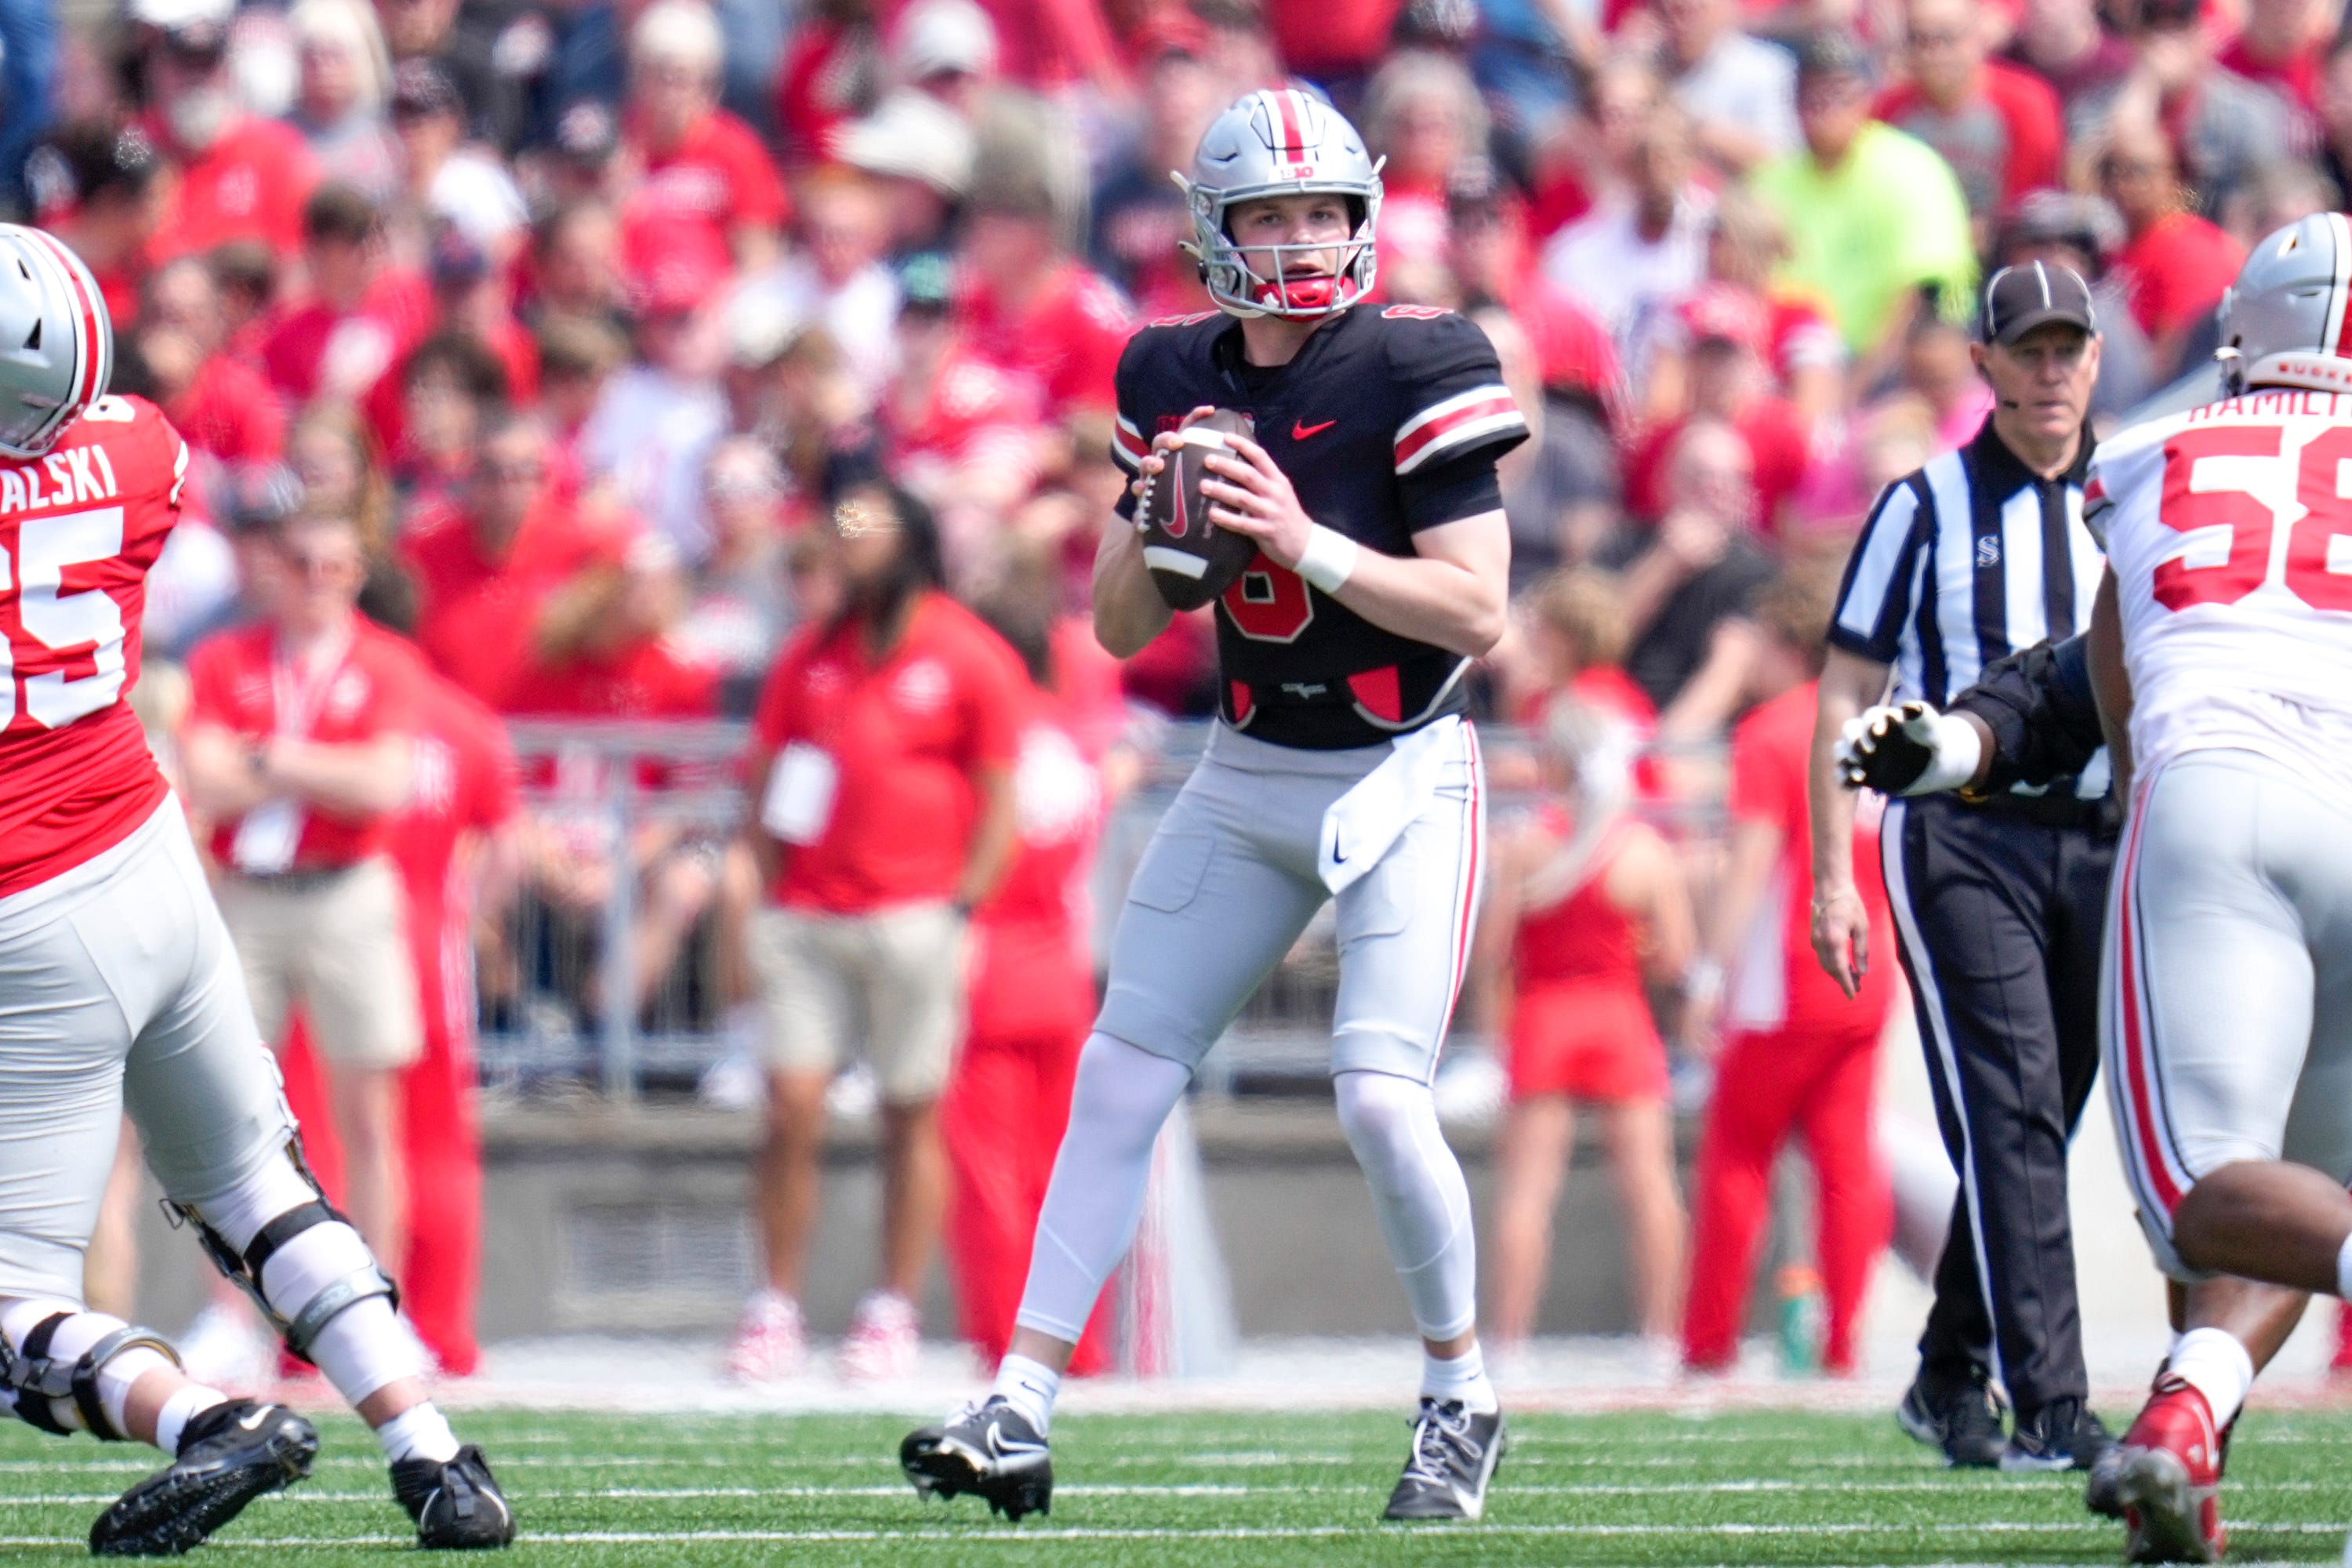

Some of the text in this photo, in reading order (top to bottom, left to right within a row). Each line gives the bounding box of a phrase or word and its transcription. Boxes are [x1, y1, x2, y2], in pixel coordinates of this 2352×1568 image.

[2188, 392, 2352, 423] HAMILT
[2153, 425, 2352, 612] 58
[0, 506, 126, 731] 5
